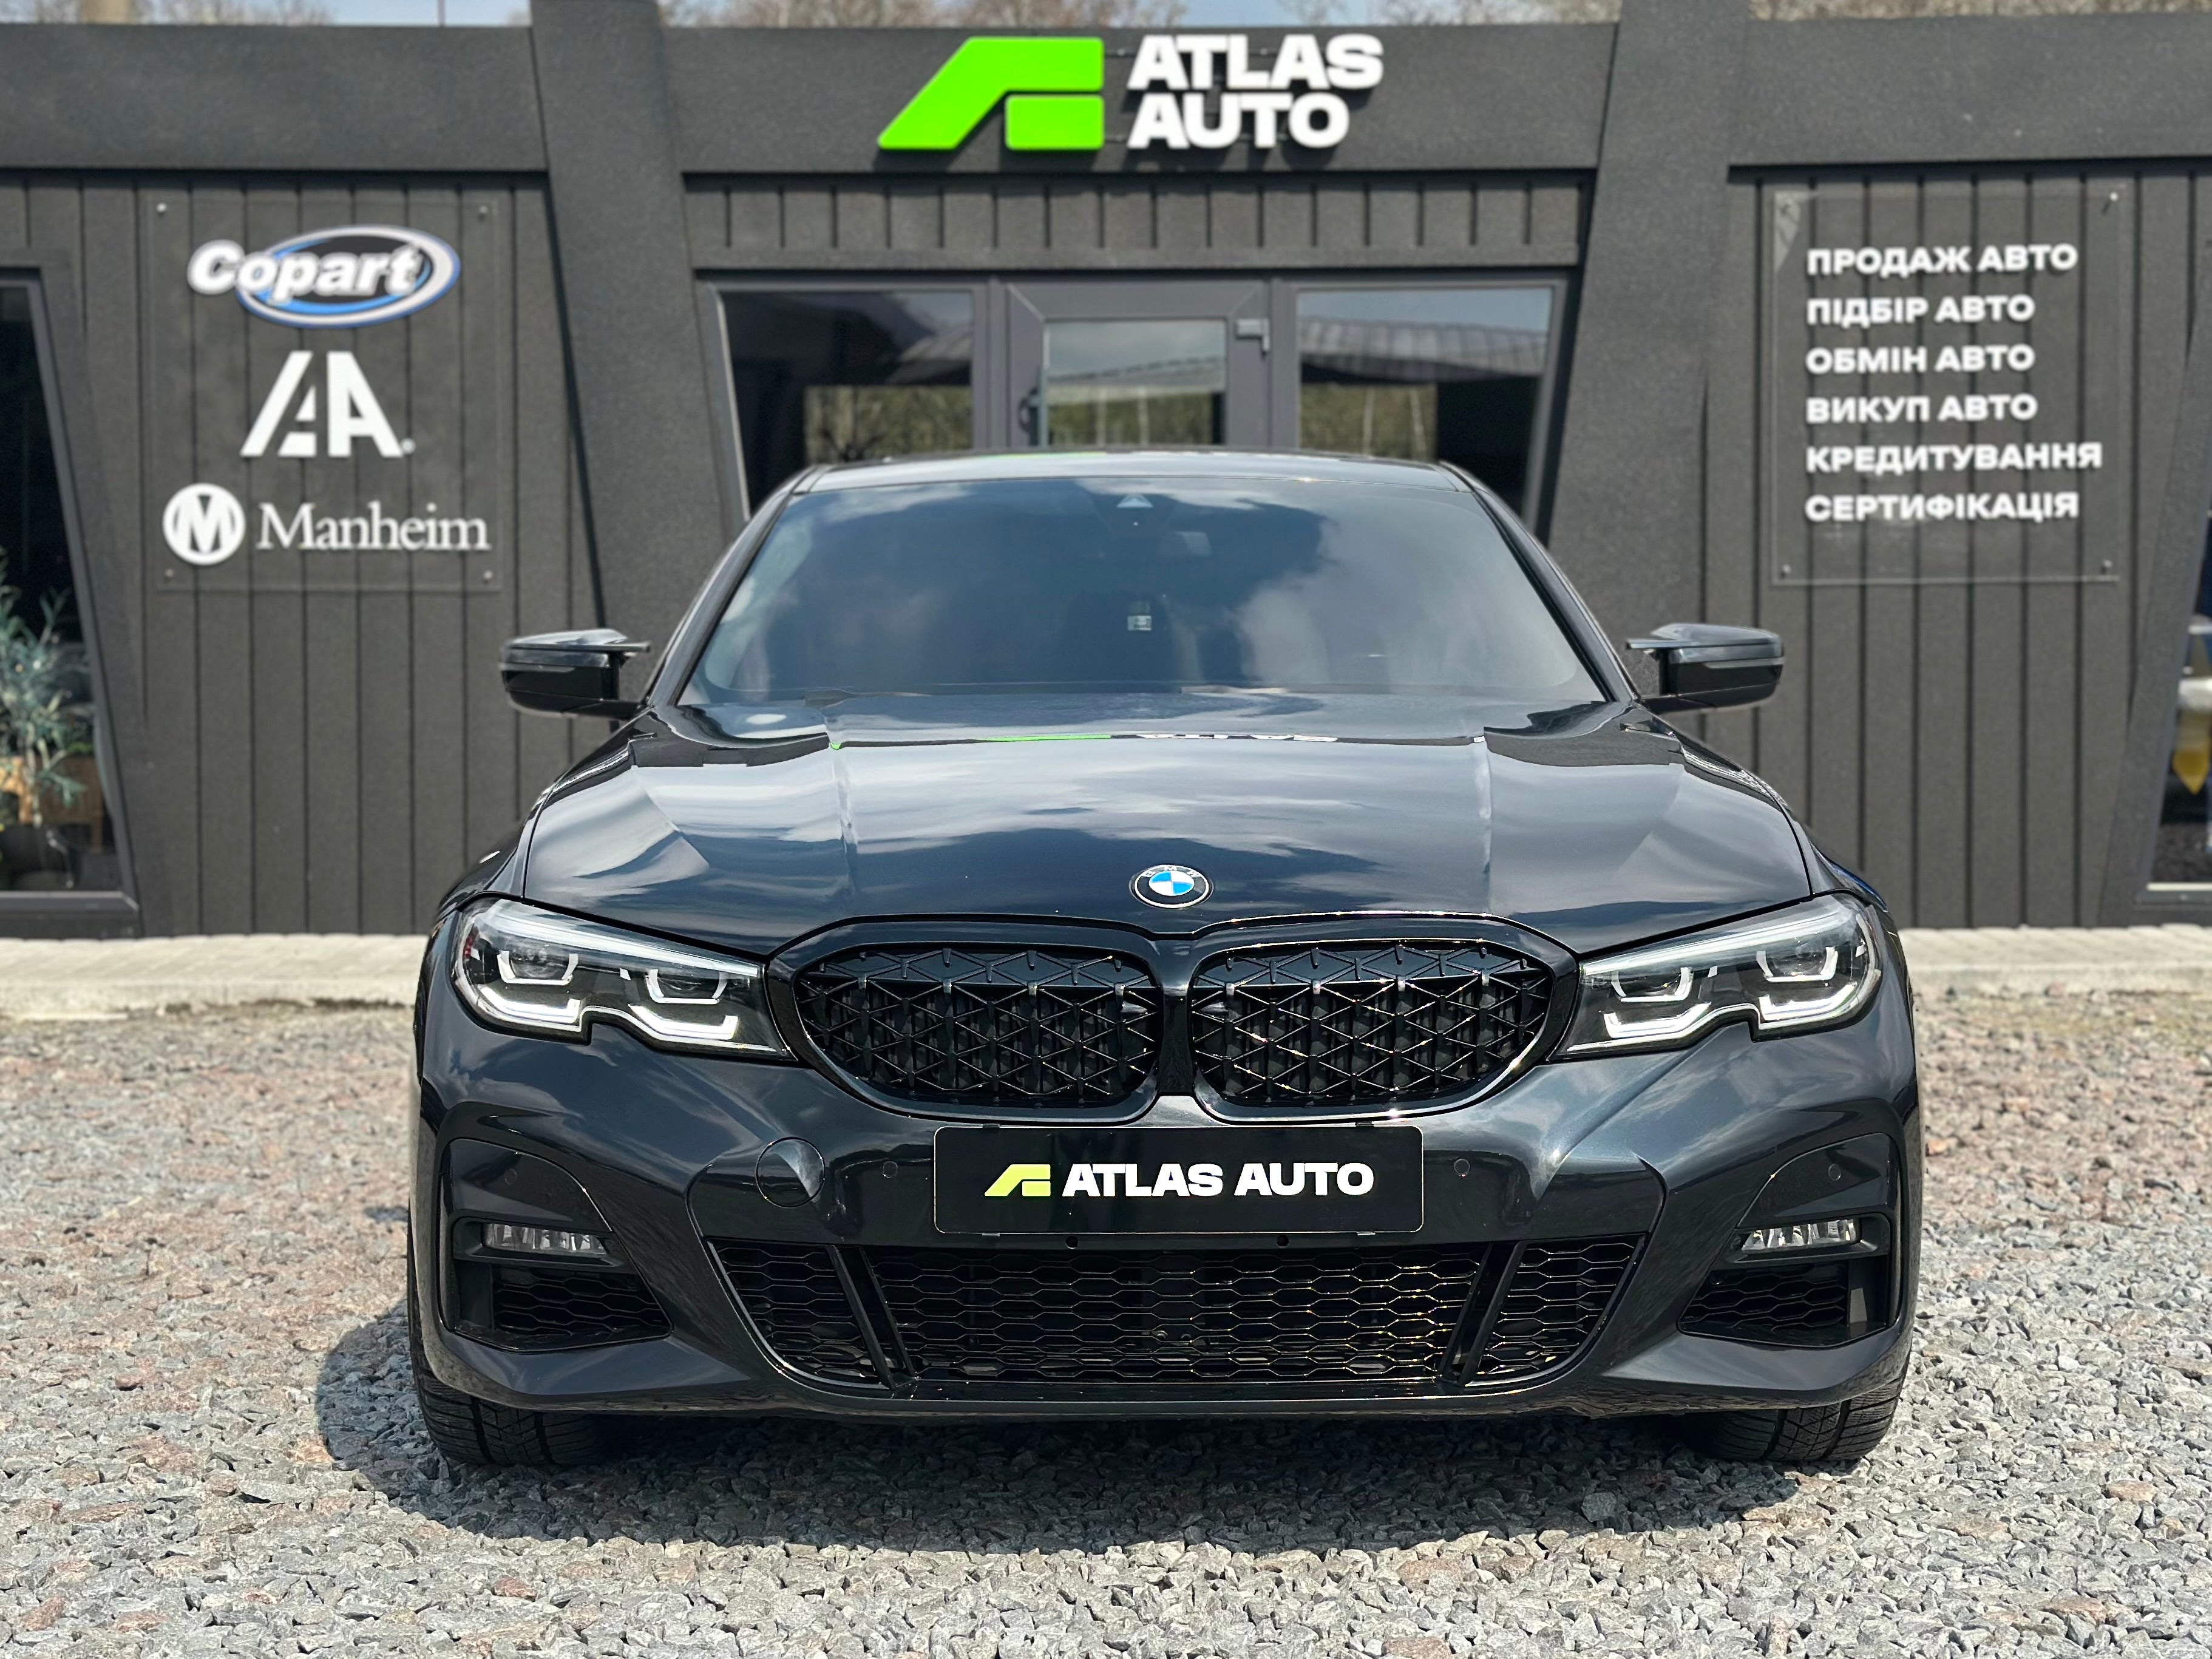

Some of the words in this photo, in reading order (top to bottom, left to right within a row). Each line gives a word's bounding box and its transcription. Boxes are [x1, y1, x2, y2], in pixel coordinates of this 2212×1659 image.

[1127, 34, 1384, 89] ATLAS
[1127, 93, 1349, 148] AUTO
[188, 239, 420, 302] Copart
[1807, 246, 1971, 278] ПРОДАЖ
[1978, 243, 2078, 271] АВТО
[1807, 297, 1929, 328] ПІДБІР
[1935, 294, 2035, 322] АВТО
[1806, 347, 1927, 374] ОБМІН
[1935, 344, 2035, 371] АВТО
[1807, 396, 1930, 424] ВИКУП
[1938, 394, 2038, 421] АВТО
[1807, 443, 2103, 476] КРЕДИТУВАННЯ
[1805, 492, 2079, 523] СЕРТИФІКАЦІЯ
[257, 500, 492, 551] Manheim
[1062, 1163, 1223, 1197] ATLAS
[1233, 1162, 1375, 1196] AUTO
